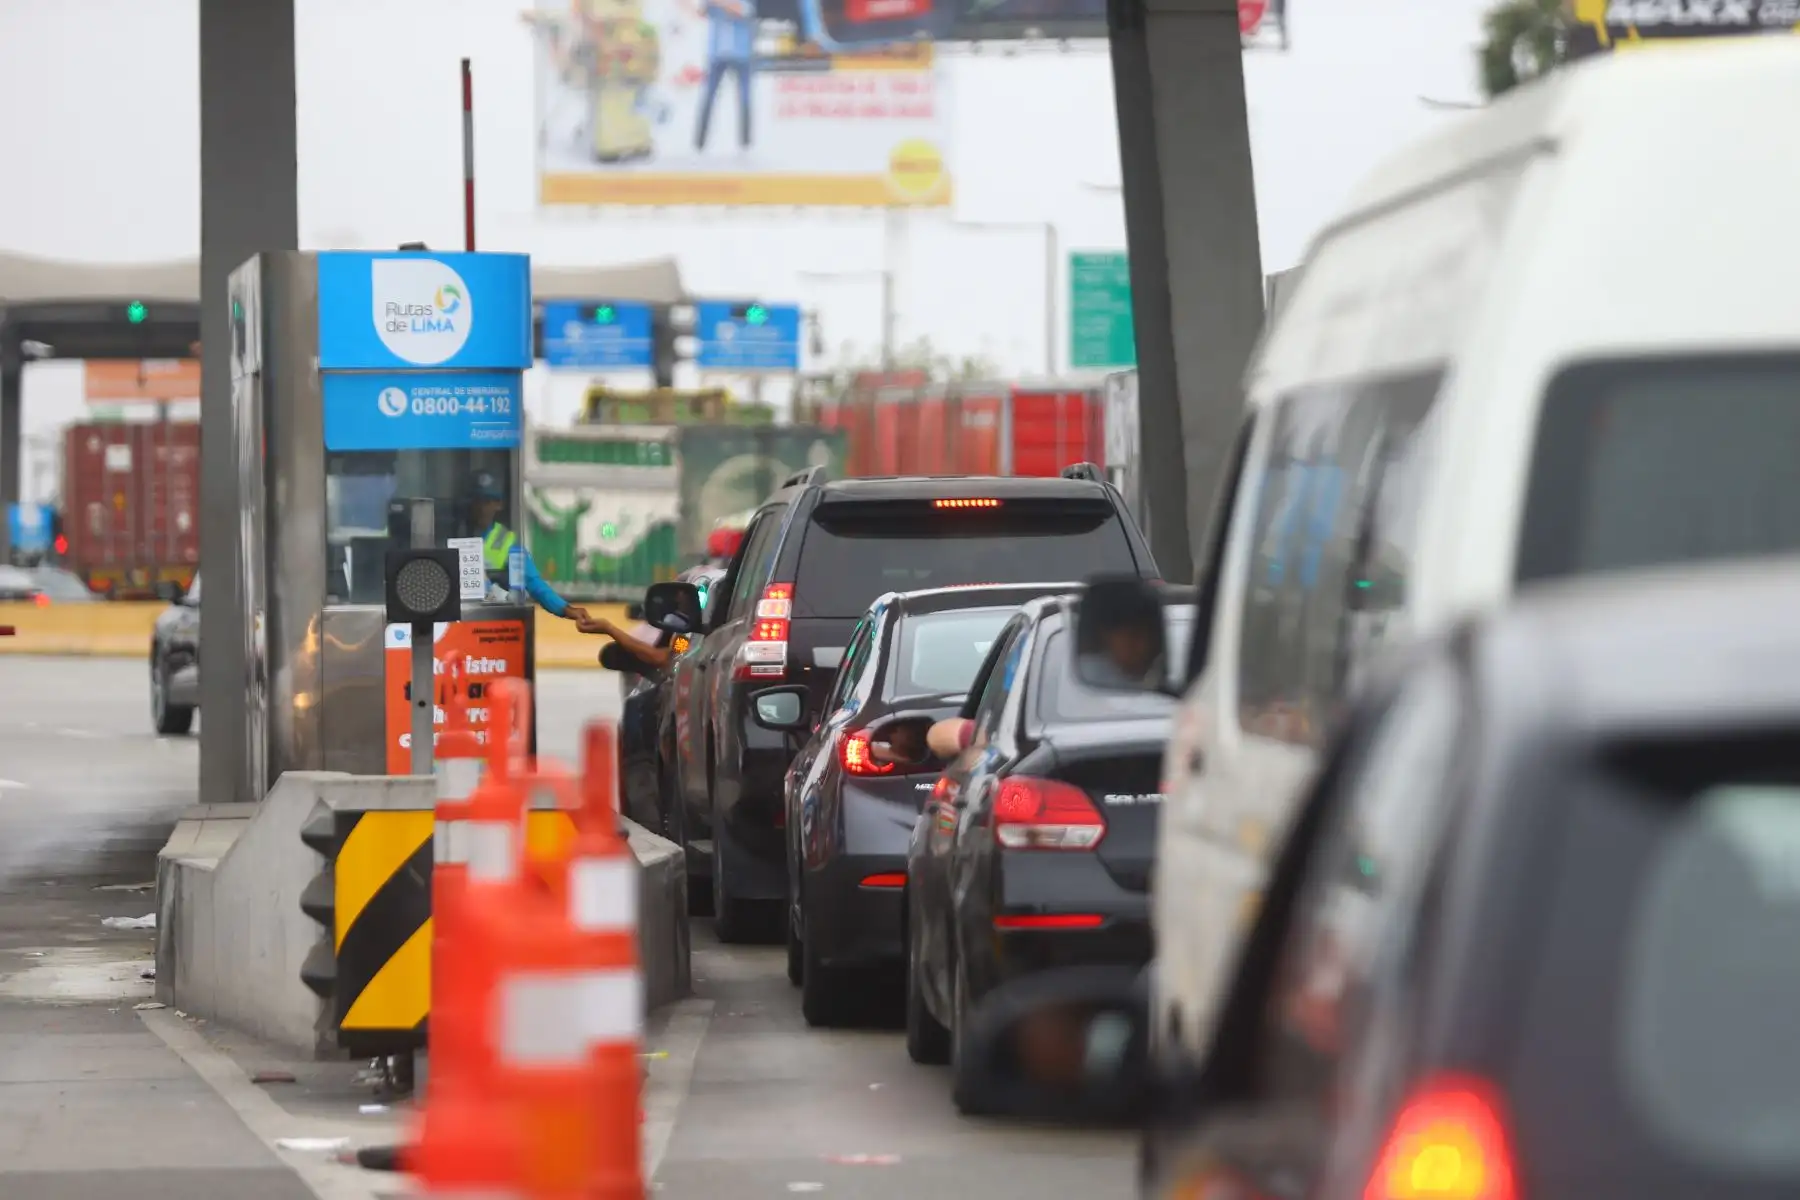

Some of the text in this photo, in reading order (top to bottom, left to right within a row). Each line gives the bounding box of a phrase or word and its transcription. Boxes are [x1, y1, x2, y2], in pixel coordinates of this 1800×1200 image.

[385, 301, 433, 317] Rutas
[385, 318, 455, 333] de LIMA
[411, 386, 452, 395] CENTRAL
[454, 386, 465, 395] DE
[411, 396, 511, 415] 0800-44-192
[462, 567, 480, 576] 6.50
[463, 580, 481, 589] 6.50
